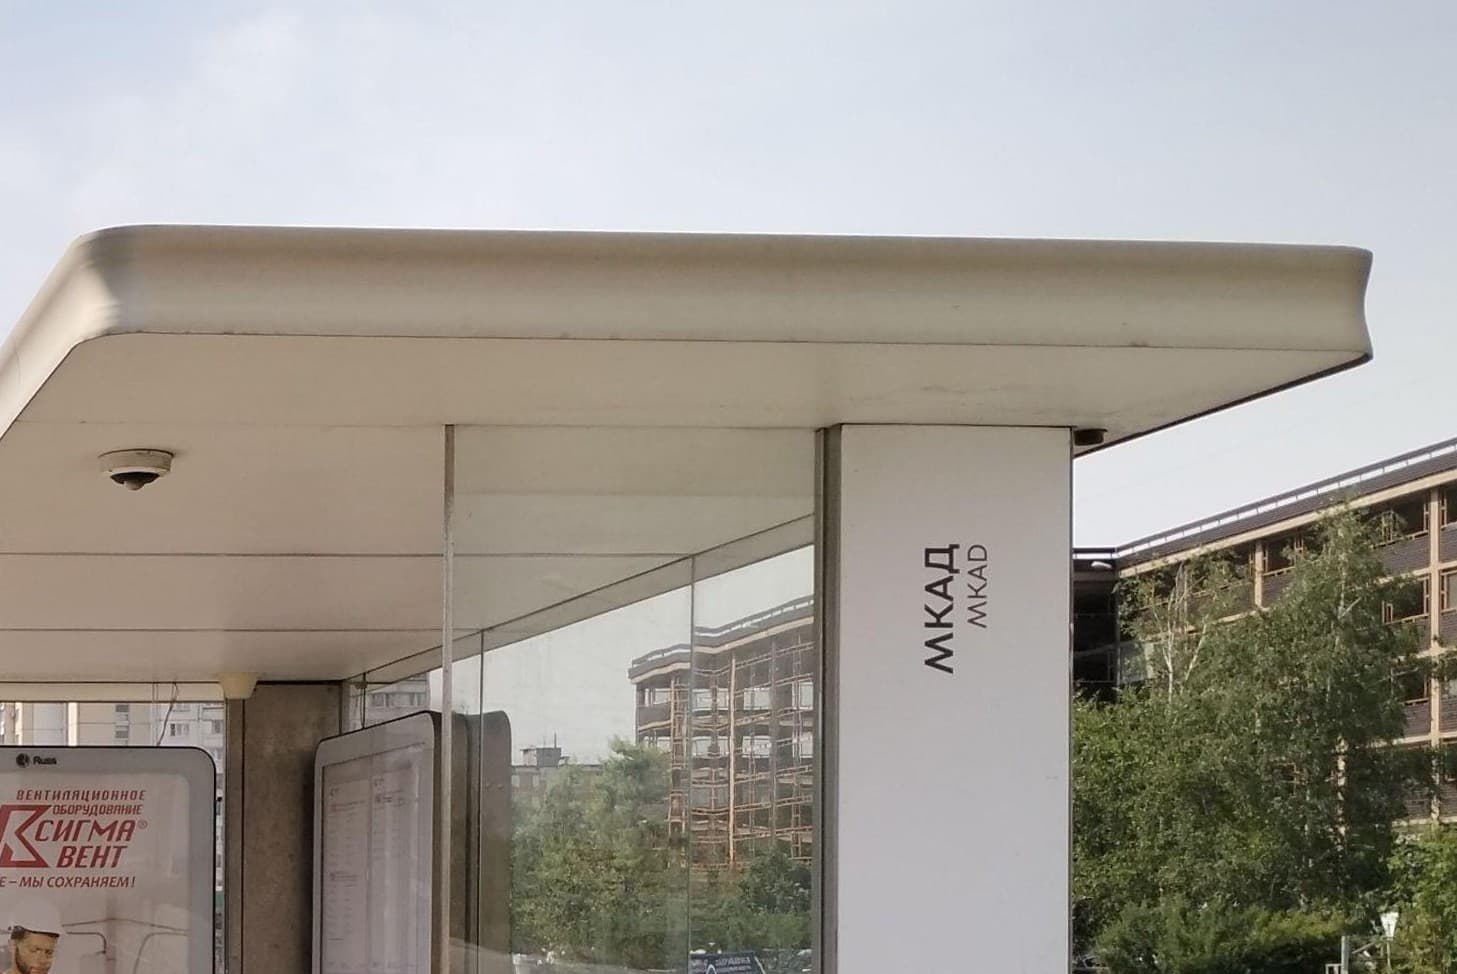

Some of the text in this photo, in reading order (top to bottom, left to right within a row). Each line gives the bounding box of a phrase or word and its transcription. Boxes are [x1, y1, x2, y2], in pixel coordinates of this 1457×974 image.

[967, 544, 988, 629] MKAD
[924, 543, 961, 675] МКАД
[17, 789, 147, 802] ВЕНТИЛЯЦИОННОЕ
[52, 804, 144, 817] ОБОРУДОВАНИЕ
[34, 819, 136, 843] СИГМА
[56, 845, 128, 869] ВЕНТ
[18, 875, 44, 888] МЫ
[47, 876, 136, 888] СОХРАНЯЕМ!
